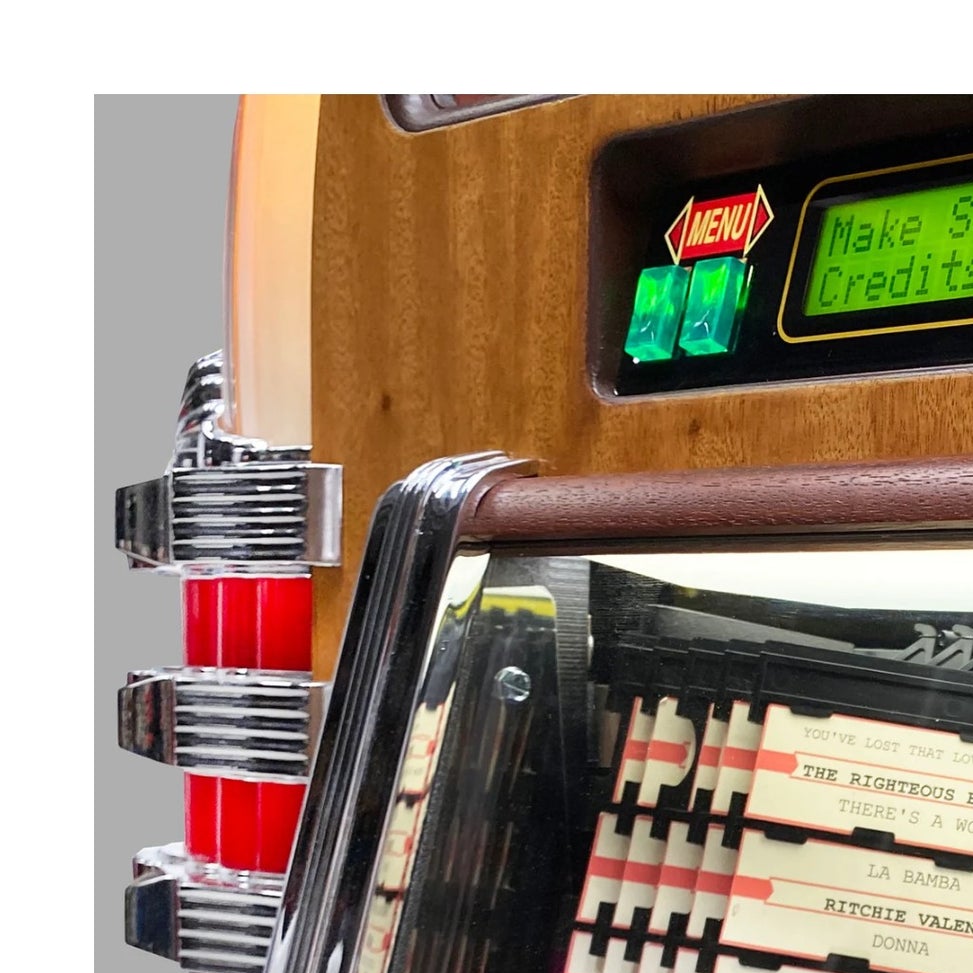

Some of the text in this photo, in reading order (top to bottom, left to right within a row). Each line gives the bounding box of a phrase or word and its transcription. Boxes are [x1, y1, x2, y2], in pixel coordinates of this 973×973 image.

[687, 201, 748, 246] MENU
[827, 207, 924, 256] Make
[802, 726, 857, 746] YOU'VE
[865, 733, 901, 753] LOST
[908, 740, 944, 759] THAT
[802, 763, 838, 783] THE
[849, 770, 956, 801] RIGHTEOUS
[838, 798, 921, 824] THERE'S
[931, 813, 944, 829] A
[867, 863, 962, 892] LA BAMBA
[824, 897, 908, 924] RITCHIE
[871, 933, 931, 956] DONNA
